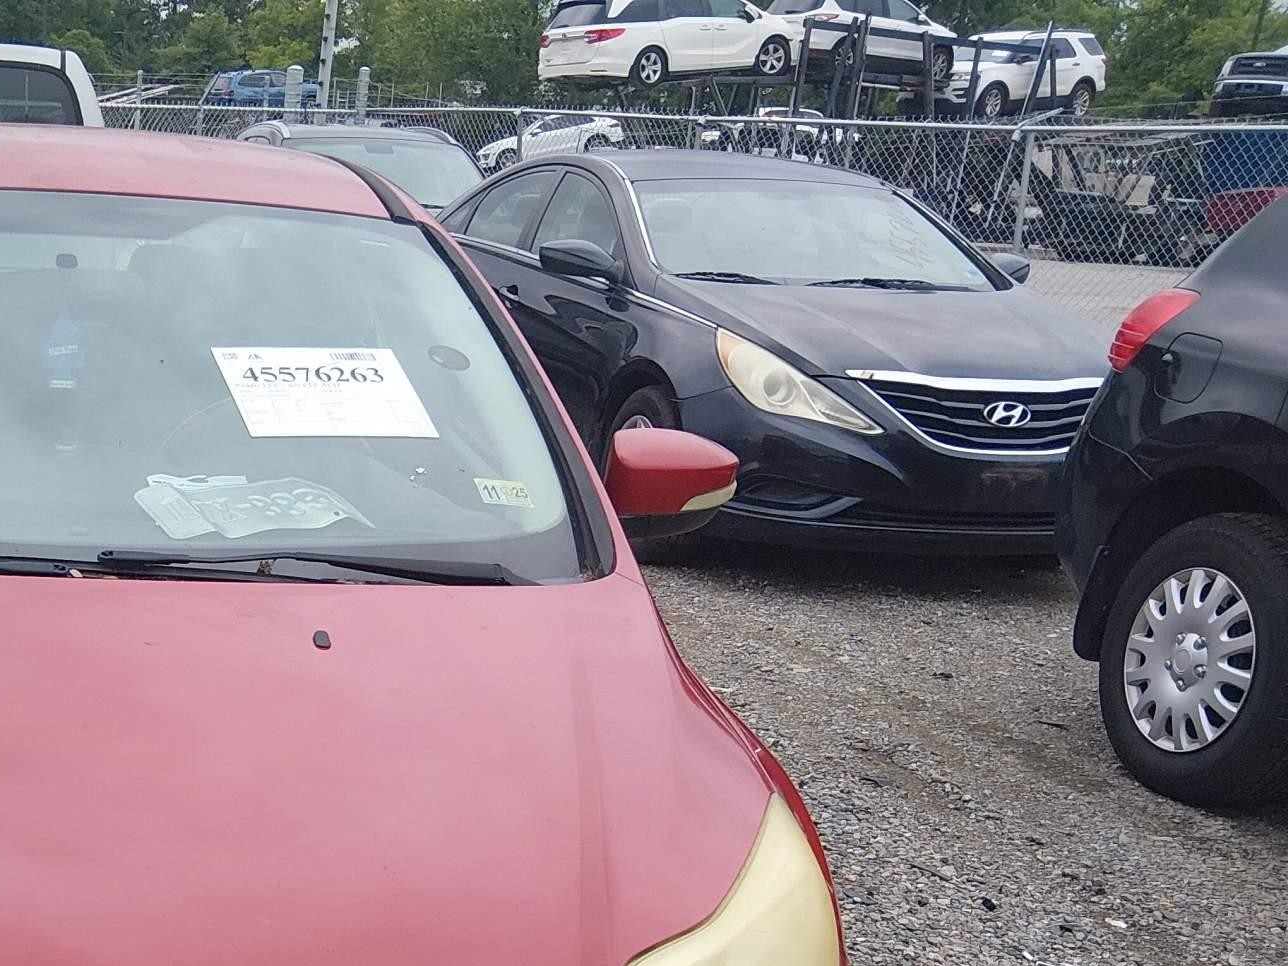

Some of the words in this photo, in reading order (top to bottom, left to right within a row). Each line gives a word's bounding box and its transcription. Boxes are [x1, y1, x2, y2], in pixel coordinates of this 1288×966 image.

[242, 365, 385, 384] 45576263
[482, 484, 501, 500] 11
[511, 486, 529, 499] 25
